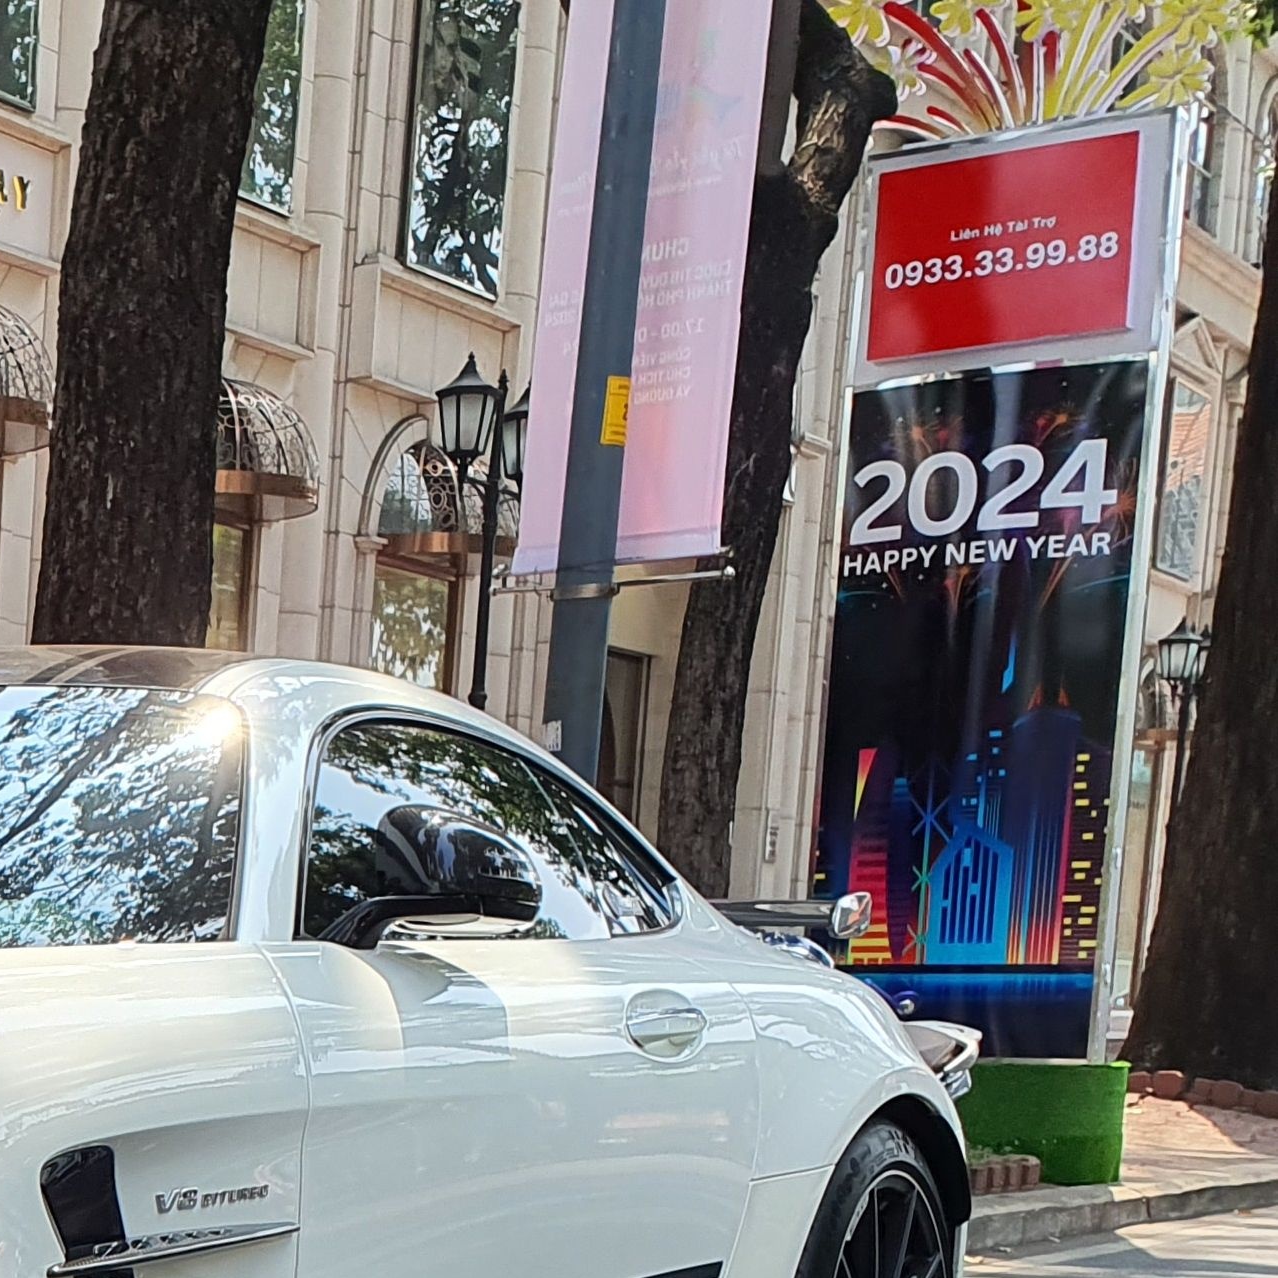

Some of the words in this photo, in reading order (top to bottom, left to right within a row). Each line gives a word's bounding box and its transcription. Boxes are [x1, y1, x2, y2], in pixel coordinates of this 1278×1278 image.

[950, 228, 980, 242] Liên
[885, 231, 1119, 289] 0933.33.99.88
[849, 438, 1118, 546] 2024
[843, 544, 937, 577] HAPPY
[944, 537, 1017, 566] NEW
[1026, 532, 1111, 560] YEAR
[155, 1187, 198, 1215] V8
